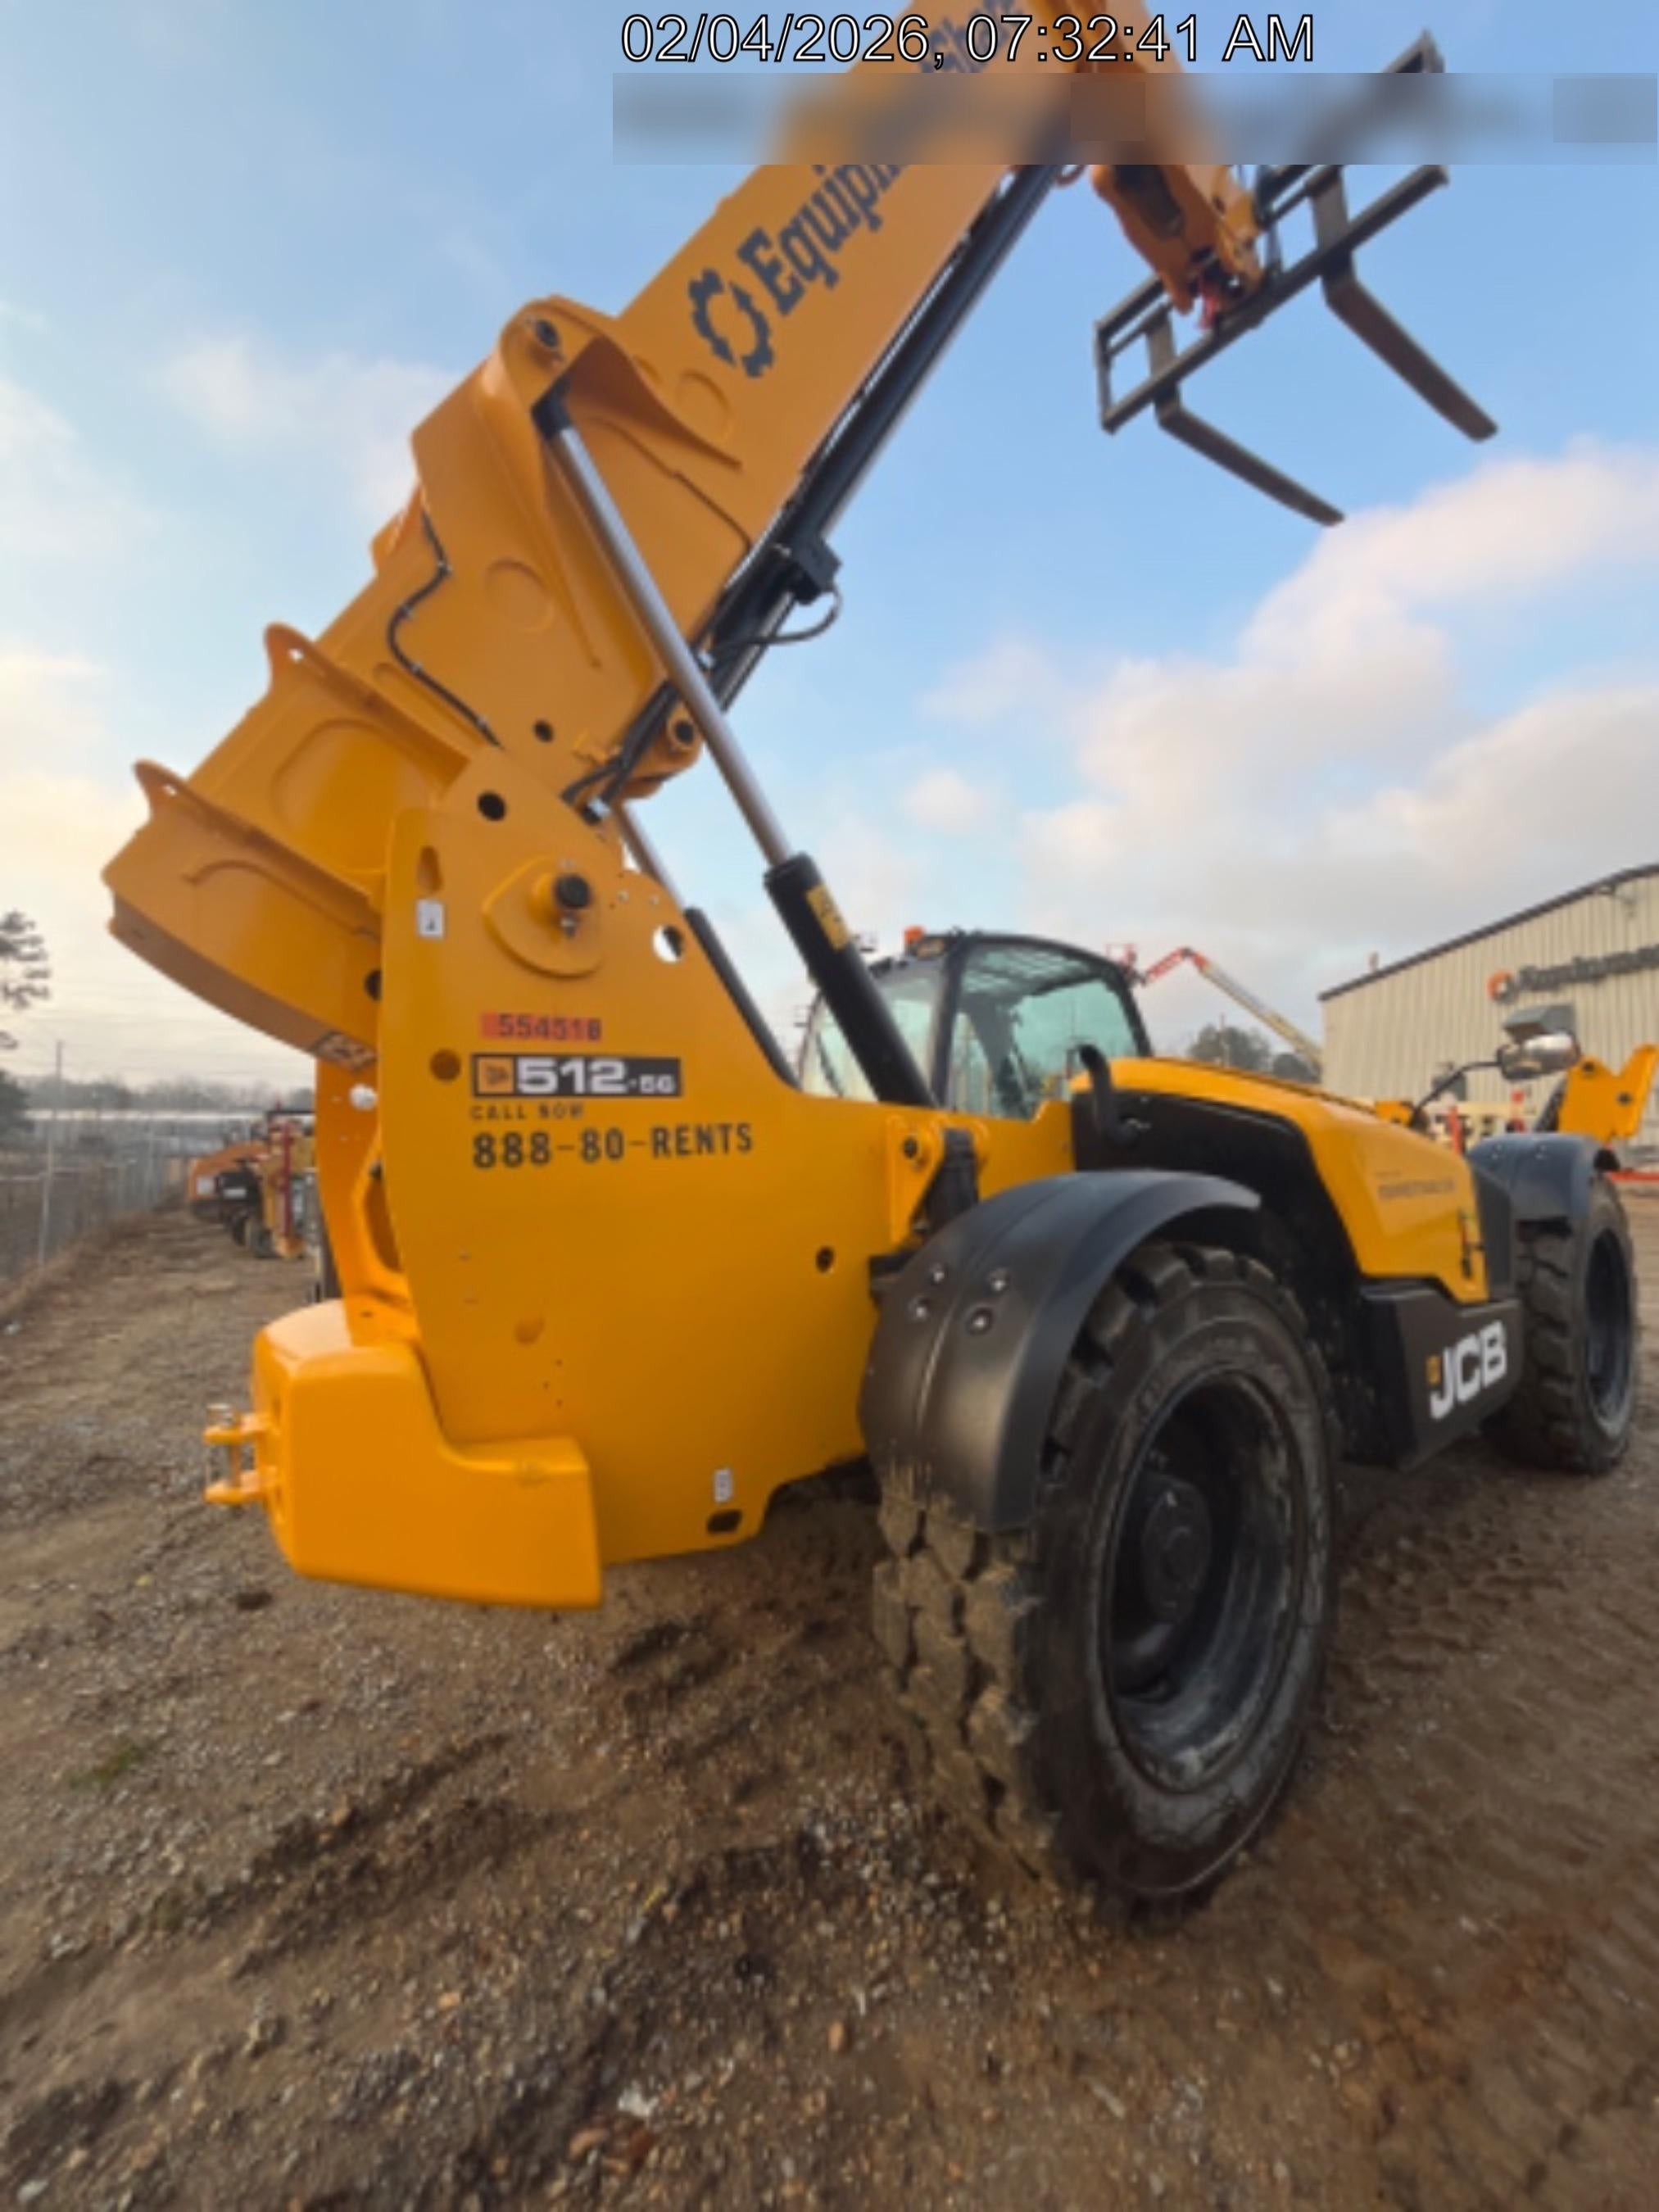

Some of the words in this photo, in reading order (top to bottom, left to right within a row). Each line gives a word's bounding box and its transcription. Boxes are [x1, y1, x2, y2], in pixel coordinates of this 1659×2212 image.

[736, 164, 907, 317] Equip
[471, 1105, 526, 1121] CALL
[539, 1104, 584, 1119] NOW
[473, 1122, 753, 1169] 888-80-RENTS
[1430, 1320, 1507, 1420] JCB
